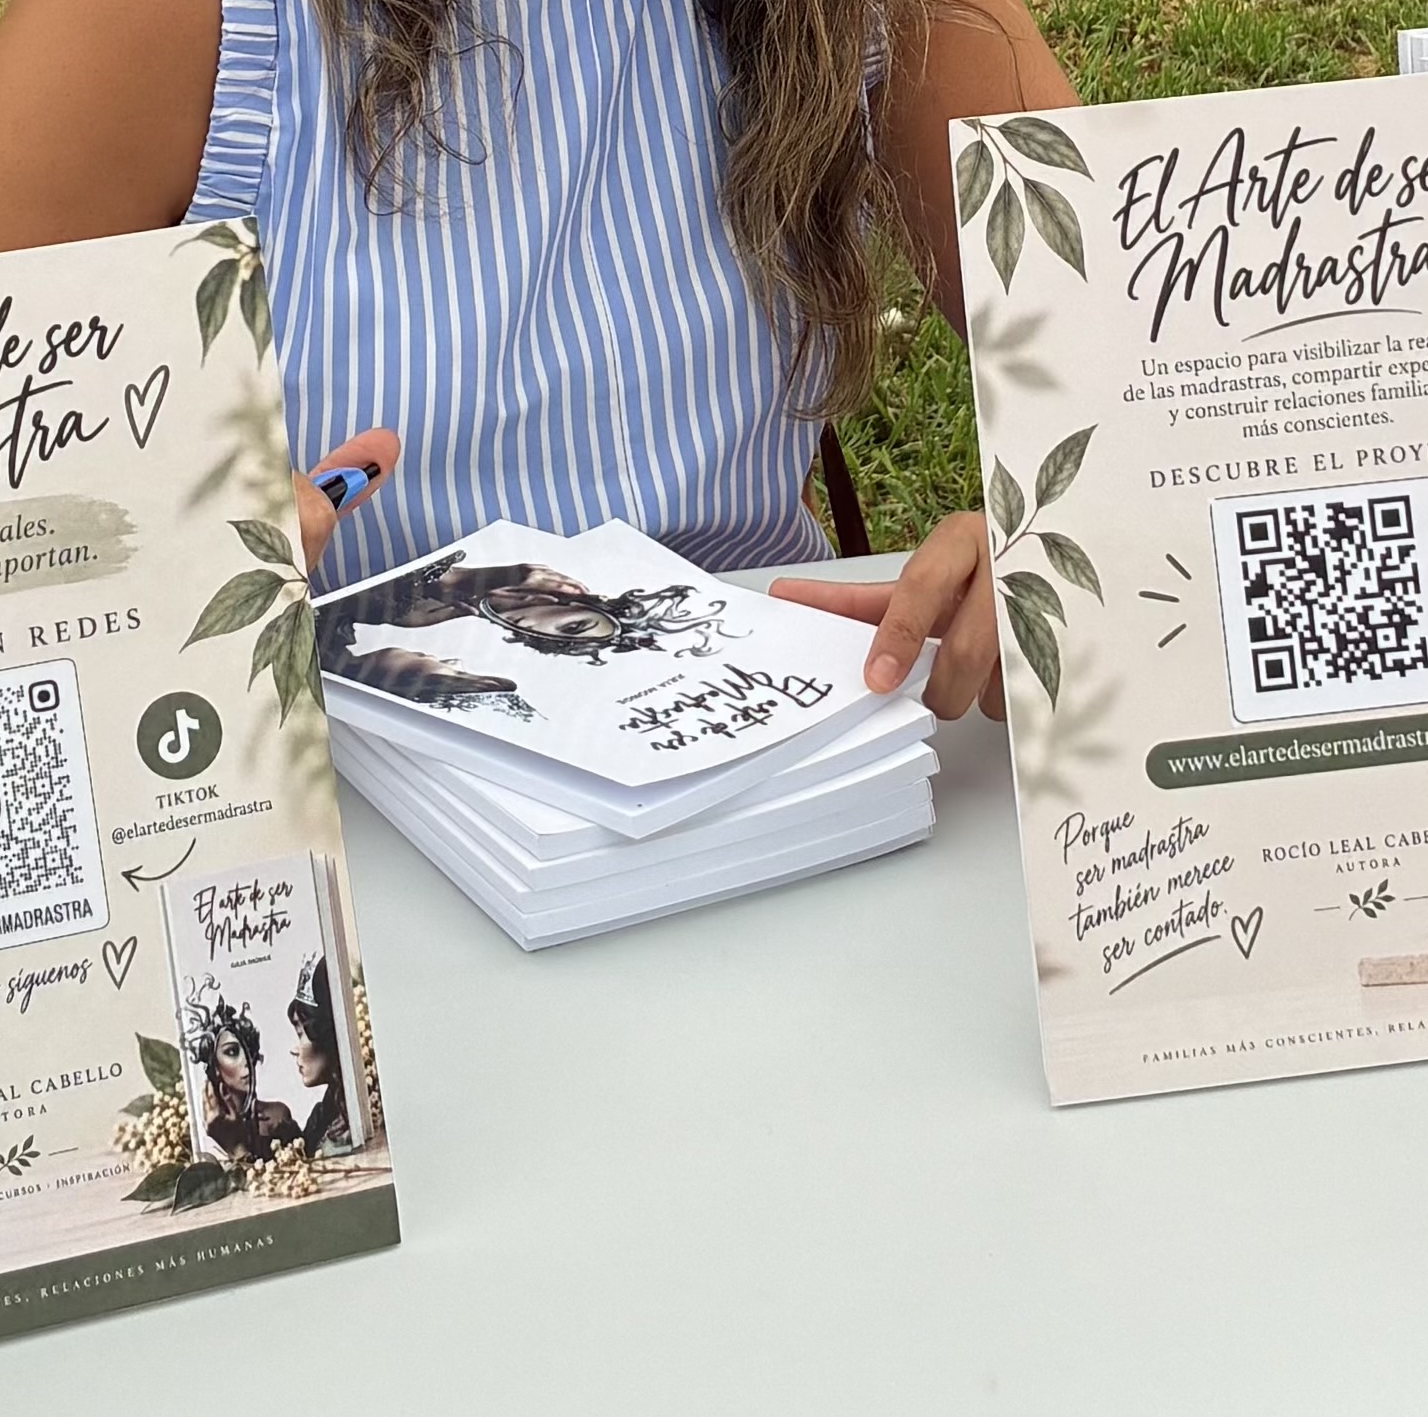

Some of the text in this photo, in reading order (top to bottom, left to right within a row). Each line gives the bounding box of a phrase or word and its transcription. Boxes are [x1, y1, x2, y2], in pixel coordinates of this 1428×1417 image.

[1112, 147, 1180, 251] El
[1178, 126, 1338, 230] Arte
[1334, 127, 1394, 216] de
[38, 315, 125, 375] ser
[1141, 358, 1169, 377] Un
[1174, 351, 1242, 377] espacio
[1247, 351, 1288, 372] para
[1292, 338, 1382, 365] visibilizar
[1385, 334, 1404, 353] la
[1123, 383, 1146, 403] de
[1149, 381, 1175, 400] las
[1180, 374, 1287, 400] madrastras,
[1291, 360, 1383, 390] compartir
[1168, 408, 1180, 427] y
[1185, 395, 1269, 420] construir
[1273, 389, 1366, 416] relaciones
[1242, 411, 1395, 439] más conscientes.
[1149, 456, 1298, 489] DESCUBRE
[1313, 452, 1344, 472] EL
[28, 607, 141, 648] REDES
[155, 783, 220, 810] TIKTOK
[111, 796, 273, 845] @elartedesermadrastra
[1053, 811, 1136, 865] Porque
[1076, 816, 1211, 897] ser madrastra
[1262, 841, 1321, 863] ROCÍO
[1329, 836, 1376, 855] LEAL
[1335, 856, 1401, 874] AUTORA
[1068, 853, 1235, 942] también merece
[1102, 886, 1228, 975] ser contado.
[5, 958, 93, 1015] síguenos
[30, 1062, 123, 1095] CABELLO
